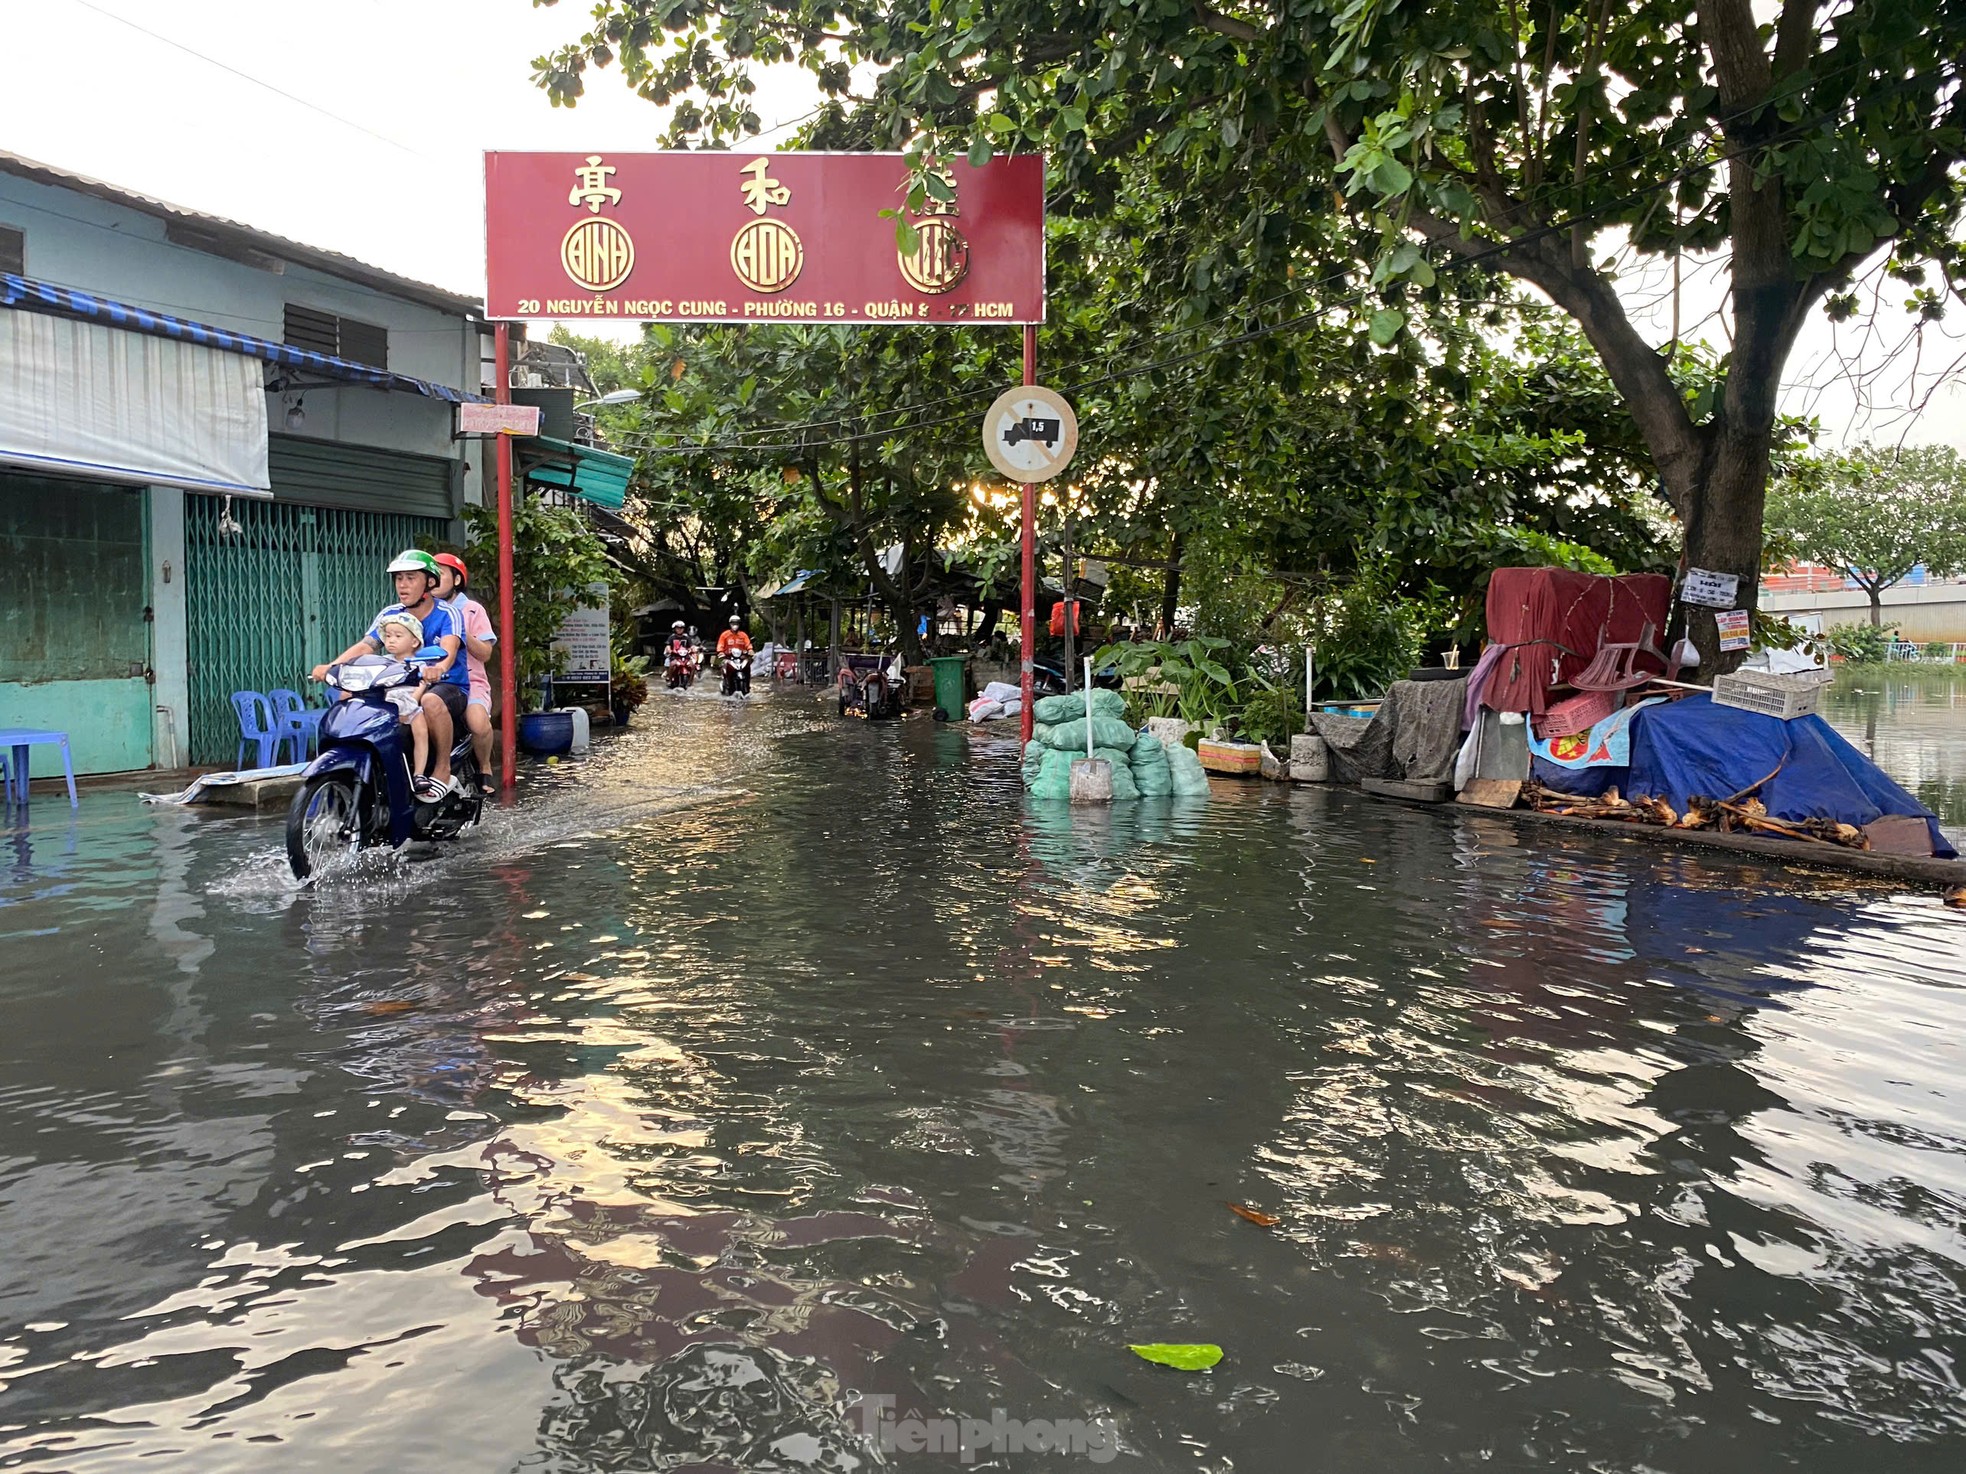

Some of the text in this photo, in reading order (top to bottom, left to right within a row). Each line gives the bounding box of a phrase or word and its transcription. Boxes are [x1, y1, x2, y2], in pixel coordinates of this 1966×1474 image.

[739, 157, 791, 215] 和
[517, 299, 541, 314] 20
[546, 294, 619, 315] NGUYỄN
[624, 299, 673, 319] NGỌC
[678, 299, 727, 316] CUNG
[744, 298, 817, 318] PHƯỜNG
[823, 301, 845, 317] 16
[864, 299, 914, 320] QUẬN
